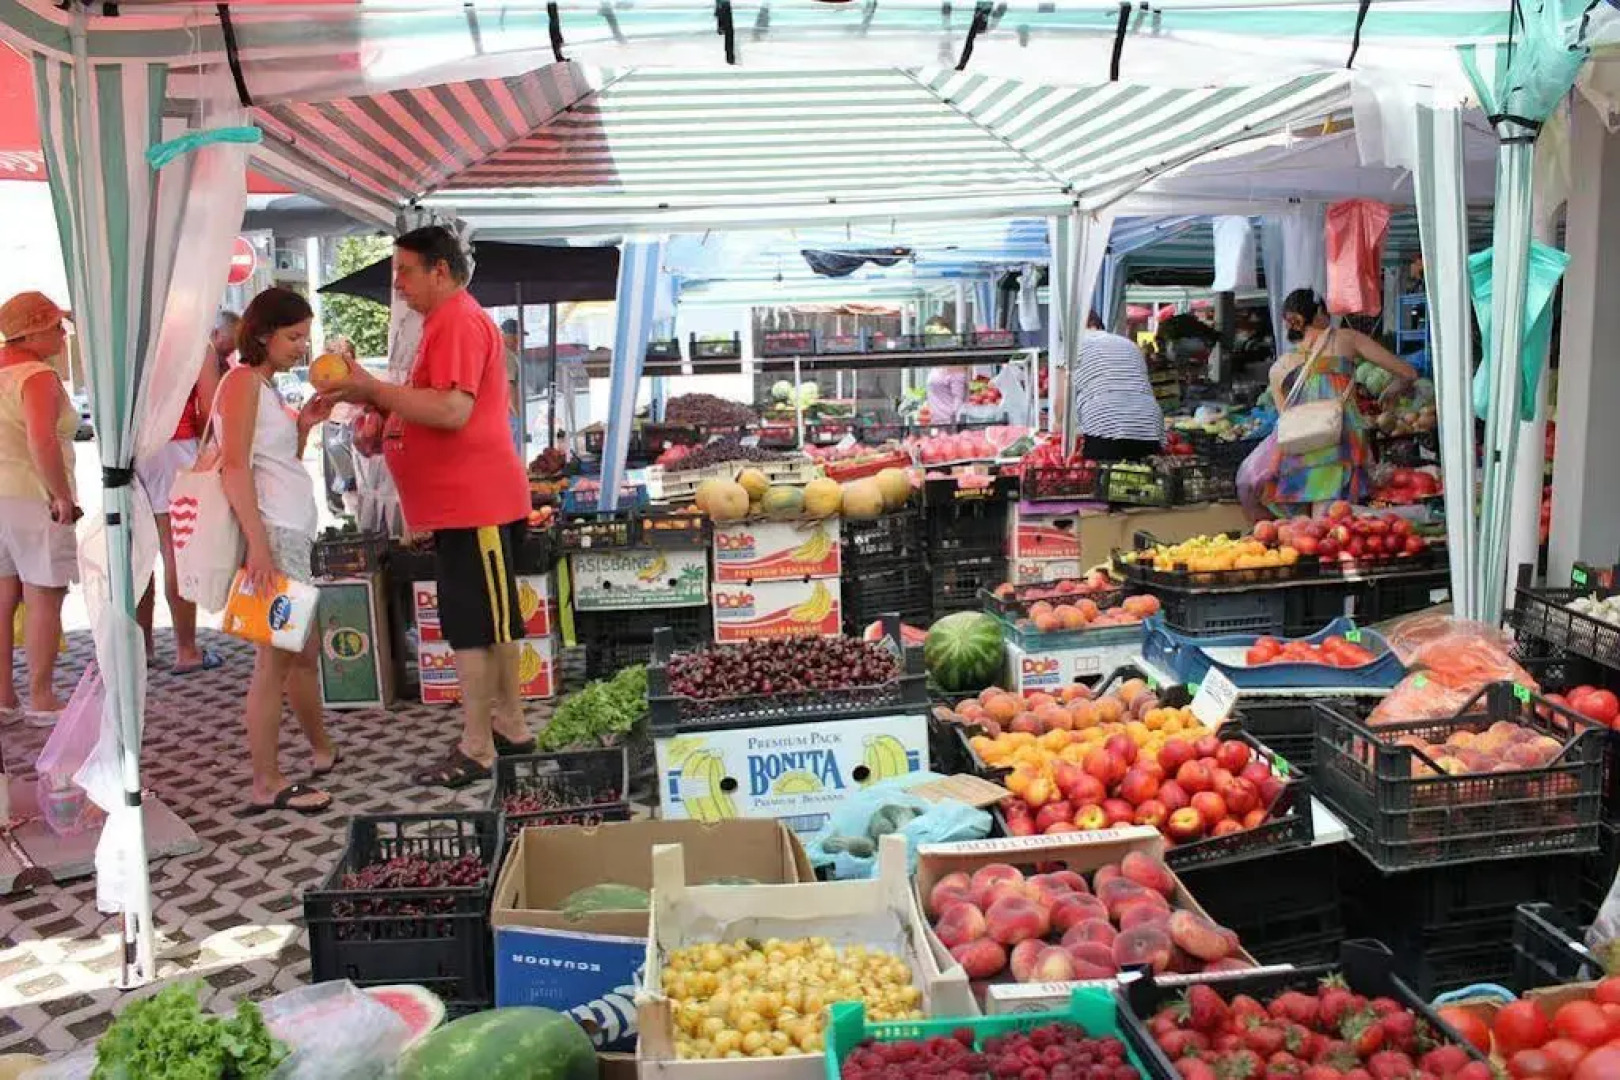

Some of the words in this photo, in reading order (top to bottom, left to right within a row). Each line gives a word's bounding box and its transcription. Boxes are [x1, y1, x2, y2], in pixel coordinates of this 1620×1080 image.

[717, 532, 755, 549] Dole
[717, 591, 755, 608] Dole
[1022, 656, 1059, 675] Dole
[748, 734, 808, 750] PREMIUM
[810, 731, 843, 745] PACK
[747, 749, 845, 795] BONITA
[512, 954, 601, 972] ECUADOR
